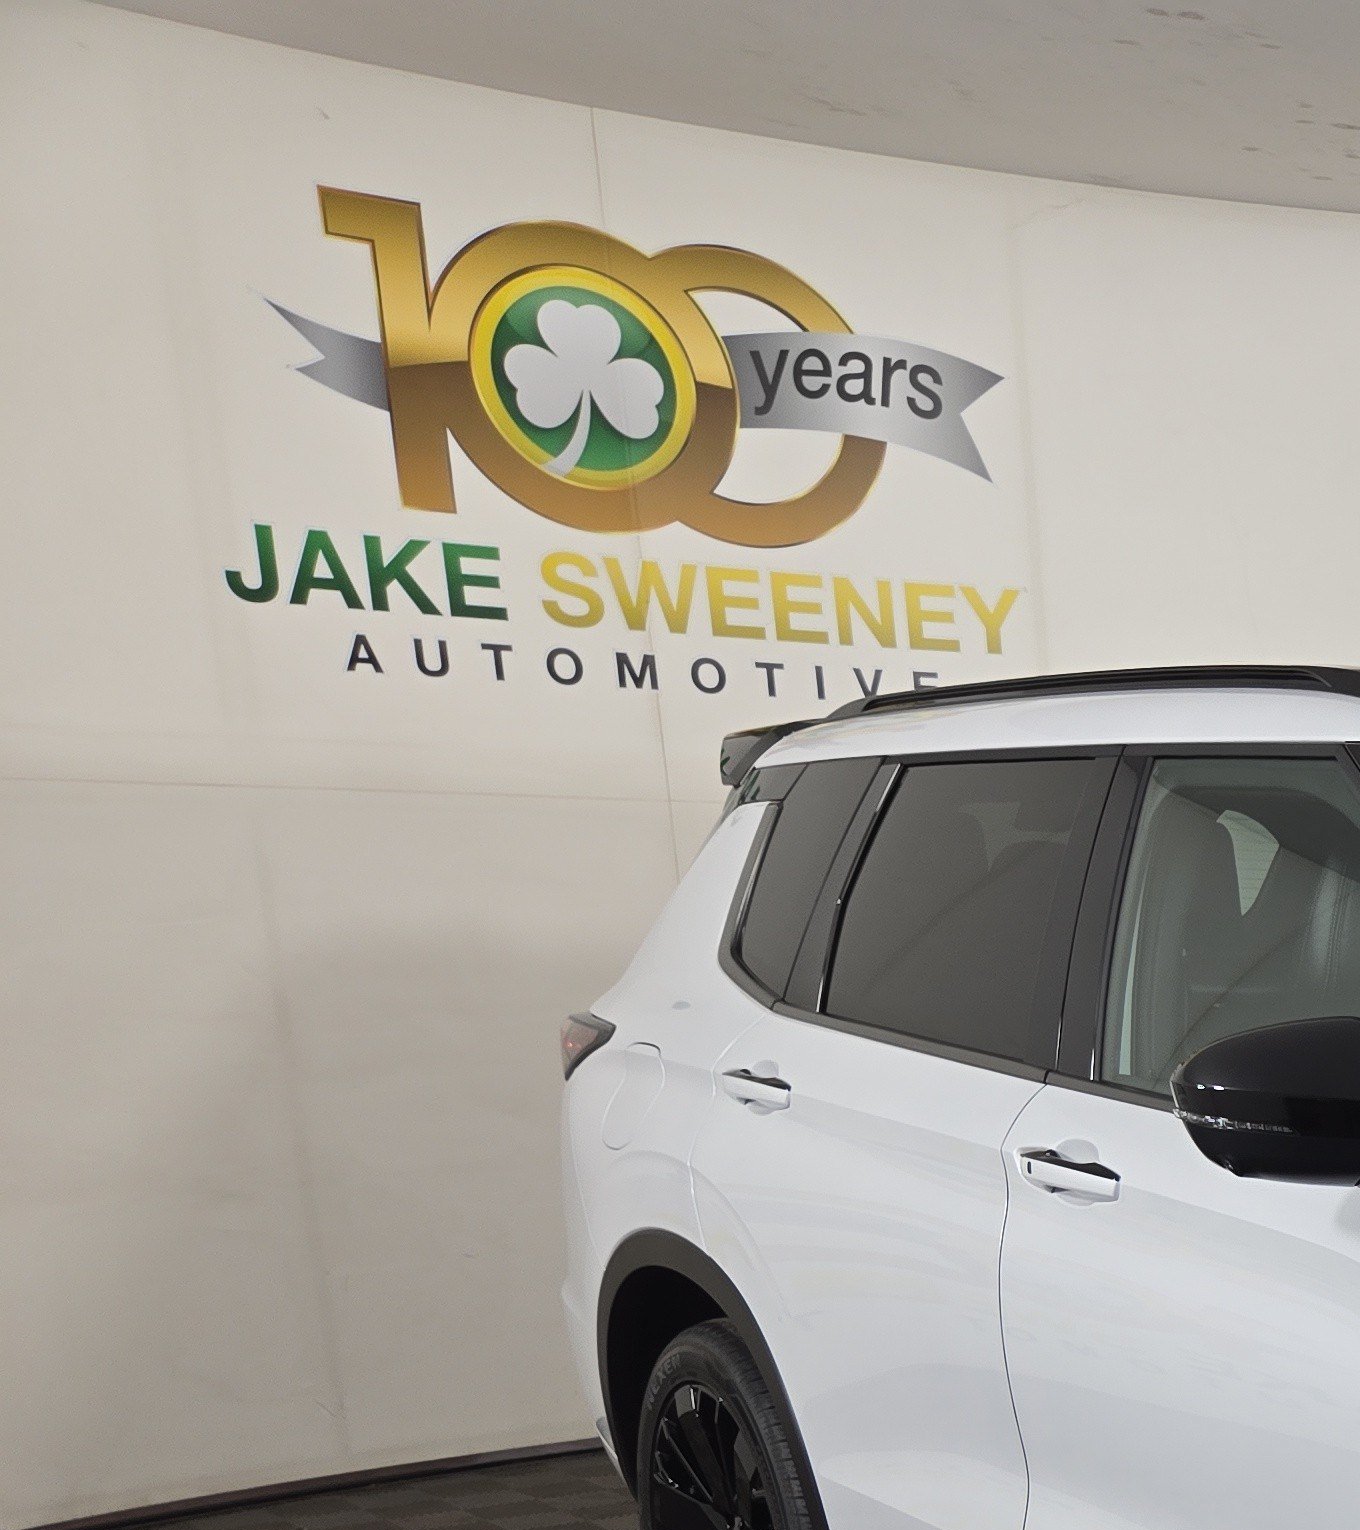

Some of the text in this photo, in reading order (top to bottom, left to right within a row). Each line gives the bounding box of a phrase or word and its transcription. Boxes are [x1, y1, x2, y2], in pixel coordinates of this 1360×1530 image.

[316, 183, 945, 549] 100 years
[224, 521, 1023, 656] JAKE SWEENEY
[345, 631, 940, 701] AUTOMOTIVE
